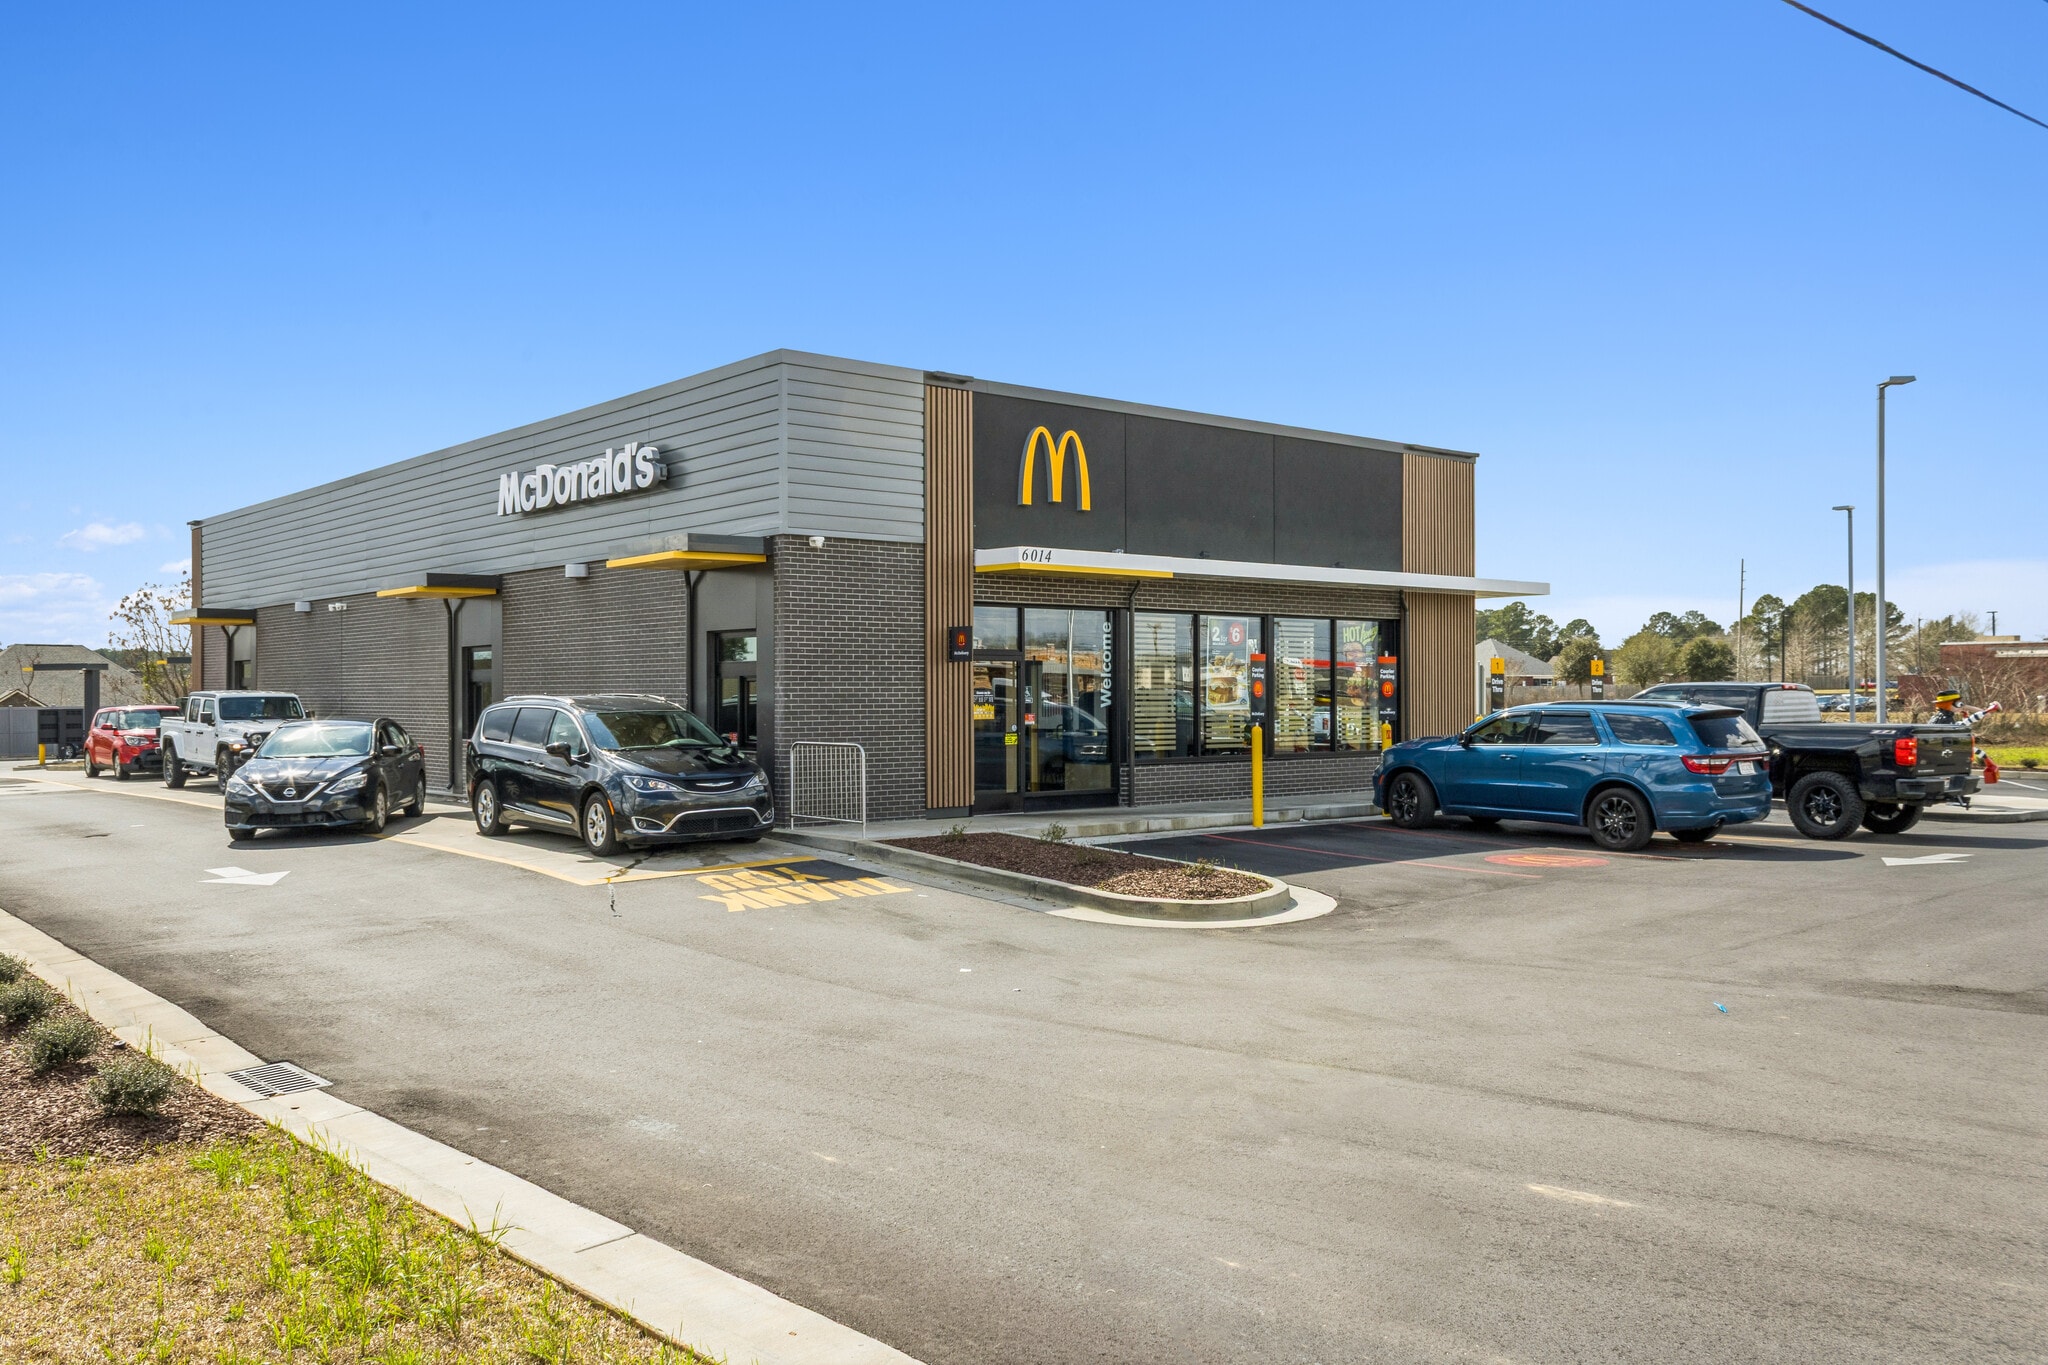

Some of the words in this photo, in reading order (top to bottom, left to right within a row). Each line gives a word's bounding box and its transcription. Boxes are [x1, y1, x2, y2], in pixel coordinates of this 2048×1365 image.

[497, 441, 660, 516] McDonald's
[1021, 548, 1052, 563] 6014
[1212, 627, 1220, 642] 2
[1343, 626, 1361, 643] HOT
[1100, 620, 1112, 708] Welcome
[1594, 663, 1600, 672] 2
[1492, 677, 1504, 685] Drive
[1591, 678, 1603, 686] Drive
[695, 866, 831, 892] YOU
[698, 876, 914, 912] THANK
